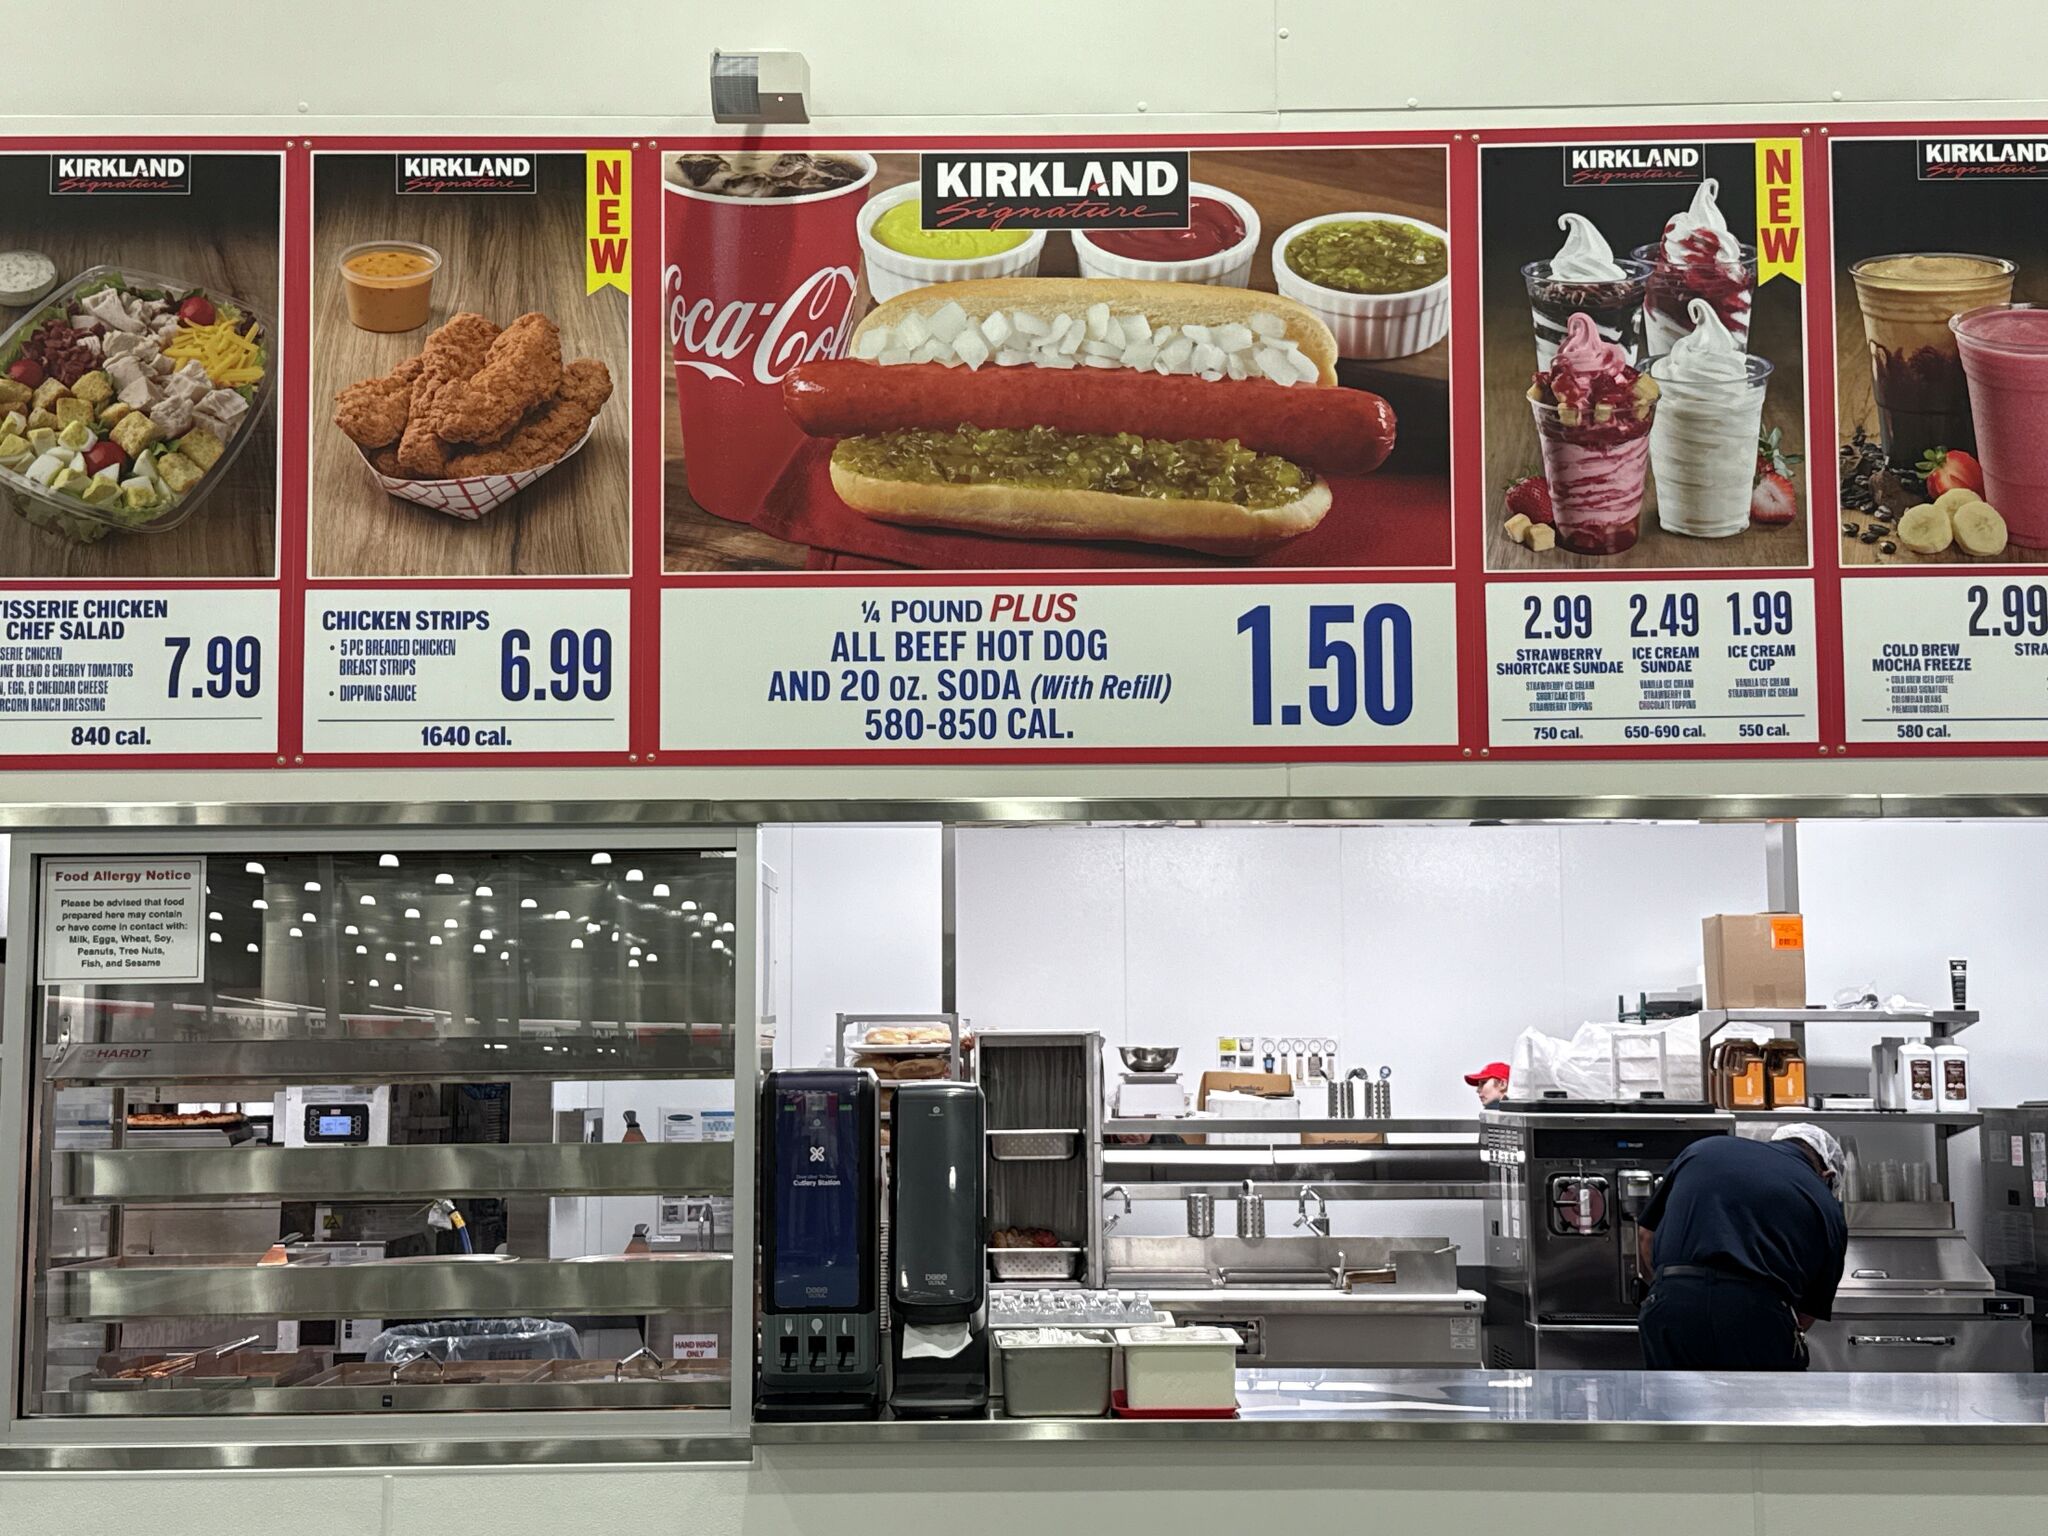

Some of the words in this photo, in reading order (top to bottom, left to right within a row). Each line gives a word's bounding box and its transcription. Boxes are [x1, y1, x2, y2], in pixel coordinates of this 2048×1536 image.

[1572, 148, 1699, 169] KIRKLAND
[1926, 143, 2048, 163] KIRKLAND
[59, 158, 185, 178] KIRKLAND
[405, 158, 530, 177] KIRKLAND
[405, 177, 530, 193] Signature
[936, 160, 1179, 199] KIRKLAND
[1572, 168, 1698, 185] Signature
[58, 178, 184, 193] Signature
[936, 197, 1178, 231] Signature
[1760, 149, 1799, 263] NEW
[590, 160, 628, 274] NEW
[0, 600, 79, 619] ISSERIE
[83, 600, 168, 619] CHICKEN
[892, 600, 982, 624] POUND
[989, 593, 1077, 624] PLUS
[1523, 594, 1593, 639] 2.99
[1629, 593, 1700, 637] 2.49
[1726, 591, 1793, 636] 1.99
[1967, 584, 2048, 637] 2.99
[322, 610, 411, 630] CHICKEN
[416, 610, 490, 630] STRIPS
[6, 621, 55, 640] CHEF
[60, 621, 125, 640] SALAD
[25, 647, 62, 661] CHICKEN
[340, 639, 348, 656] 5
[349, 639, 364, 656] PC
[365, 639, 411, 656] BREADED
[412, 639, 456, 656] CHICKEN
[831, 631, 885, 662] ALL
[895, 630, 967, 662] BEEF
[976, 630, 1034, 661] HOT
[1044, 629, 1108, 661] DOG
[1632, 647, 1653, 660] ICE
[1655, 646, 1700, 659] CREAM
[1727, 645, 1748, 658] ICE
[1750, 645, 1796, 658] CREAM
[1883, 644, 1919, 657] COLD
[1921, 643, 1960, 657] BREW
[1516, 648, 1603, 661] STRAWBERRY
[16, 663, 42, 678] BLEND
[52, 663, 86, 678] CHERRY
[88, 663, 134, 678] TOMATOES
[165, 635, 261, 698] 7.99
[340, 658, 377, 676] BREAST
[380, 658, 416, 676] STRIPS
[501, 628, 612, 702] 6.99
[1236, 603, 1414, 728] 1.50
[1496, 662, 1571, 676] SHORTCAKE
[1573, 661, 1624, 675] SUNDAE
[1641, 660, 1693, 674] SUNDAE
[1749, 659, 1775, 672] CUP
[1872, 658, 1922, 672] MOCHA
[1924, 658, 1972, 672] FREEZE
[37, 681, 76, 695] CHEDDAR
[78, 681, 109, 695] CHEESE
[340, 685, 382, 702] DIPPING
[384, 685, 417, 702] SAUCE
[768, 671, 831, 702] AND
[841, 669, 880, 701] 20
[890, 676, 928, 701] oz.
[937, 669, 1021, 701] SODA
[1031, 673, 1094, 704] (With
[1100, 673, 1172, 704] Refill)
[31, 698, 61, 712] RANCH
[62, 698, 106, 712] DRESSING
[865, 708, 997, 740] 580-850
[1007, 708, 1074, 740] CAL.
[1533, 726, 1558, 739] 750
[1560, 726, 1584, 739] cal.
[1624, 725, 1680, 738] 650-690
[1683, 725, 1706, 738] cal.
[1739, 724, 1763, 737] 550
[1766, 724, 1790, 736] cal.
[1897, 725, 1924, 738] 580
[1926, 725, 1951, 738] cal.
[71, 726, 110, 746] 840
[115, 726, 151, 746] cal.
[421, 726, 471, 746] 1640
[475, 726, 512, 746] cal.
[55, 871, 89, 882] Food
[93, 871, 142, 883] Allergy
[146, 870, 192, 881] Notice
[61, 899, 91, 908] Please
[93, 899, 104, 908] be
[106, 899, 142, 907] advised
[144, 898, 162, 907] that
[163, 898, 185, 906] food
[62, 911, 102, 922] prepared
[105, 911, 125, 919] here
[127, 912, 146, 921] may
[149, 910, 182, 919] contain
[68, 923, 90, 931] have
[119, 923, 128, 931] in
[130, 922, 164, 931] contact
[119, 947, 139, 955] Tree
[106, 959, 123, 968] and
[125, 959, 161, 968] Sesame
[96, 1049, 151, 1058] HARDT
[675, 1341, 695, 1349] HAND
[686, 1350, 704, 1358] ONLY
